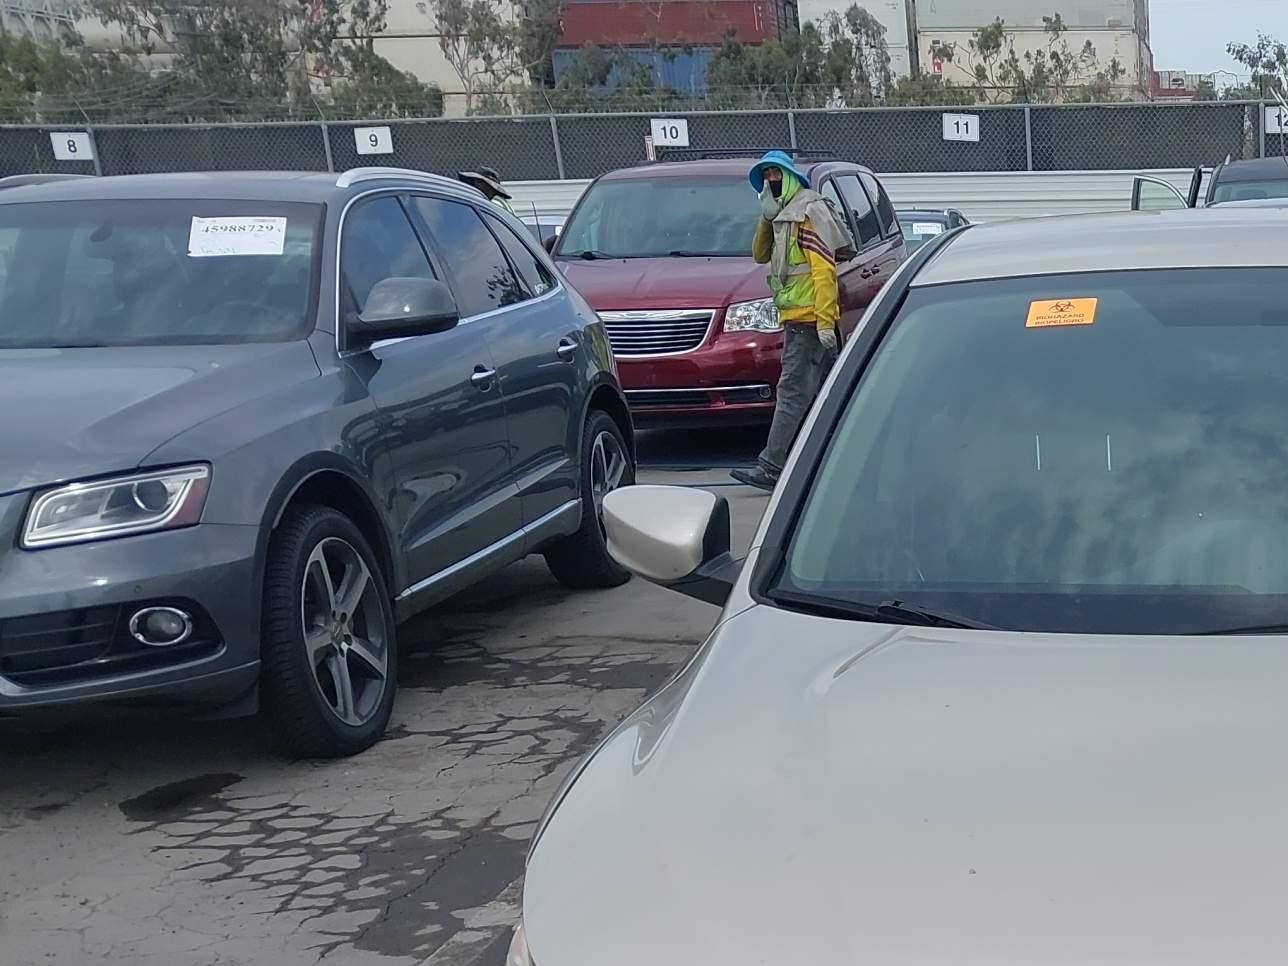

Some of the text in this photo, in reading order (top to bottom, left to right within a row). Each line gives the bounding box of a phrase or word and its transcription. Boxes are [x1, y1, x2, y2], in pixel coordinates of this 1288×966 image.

[660, 125, 679, 140] 10
[953, 120, 969, 135] 11
[67, 139, 77, 153] 8
[369, 133, 379, 147] 9
